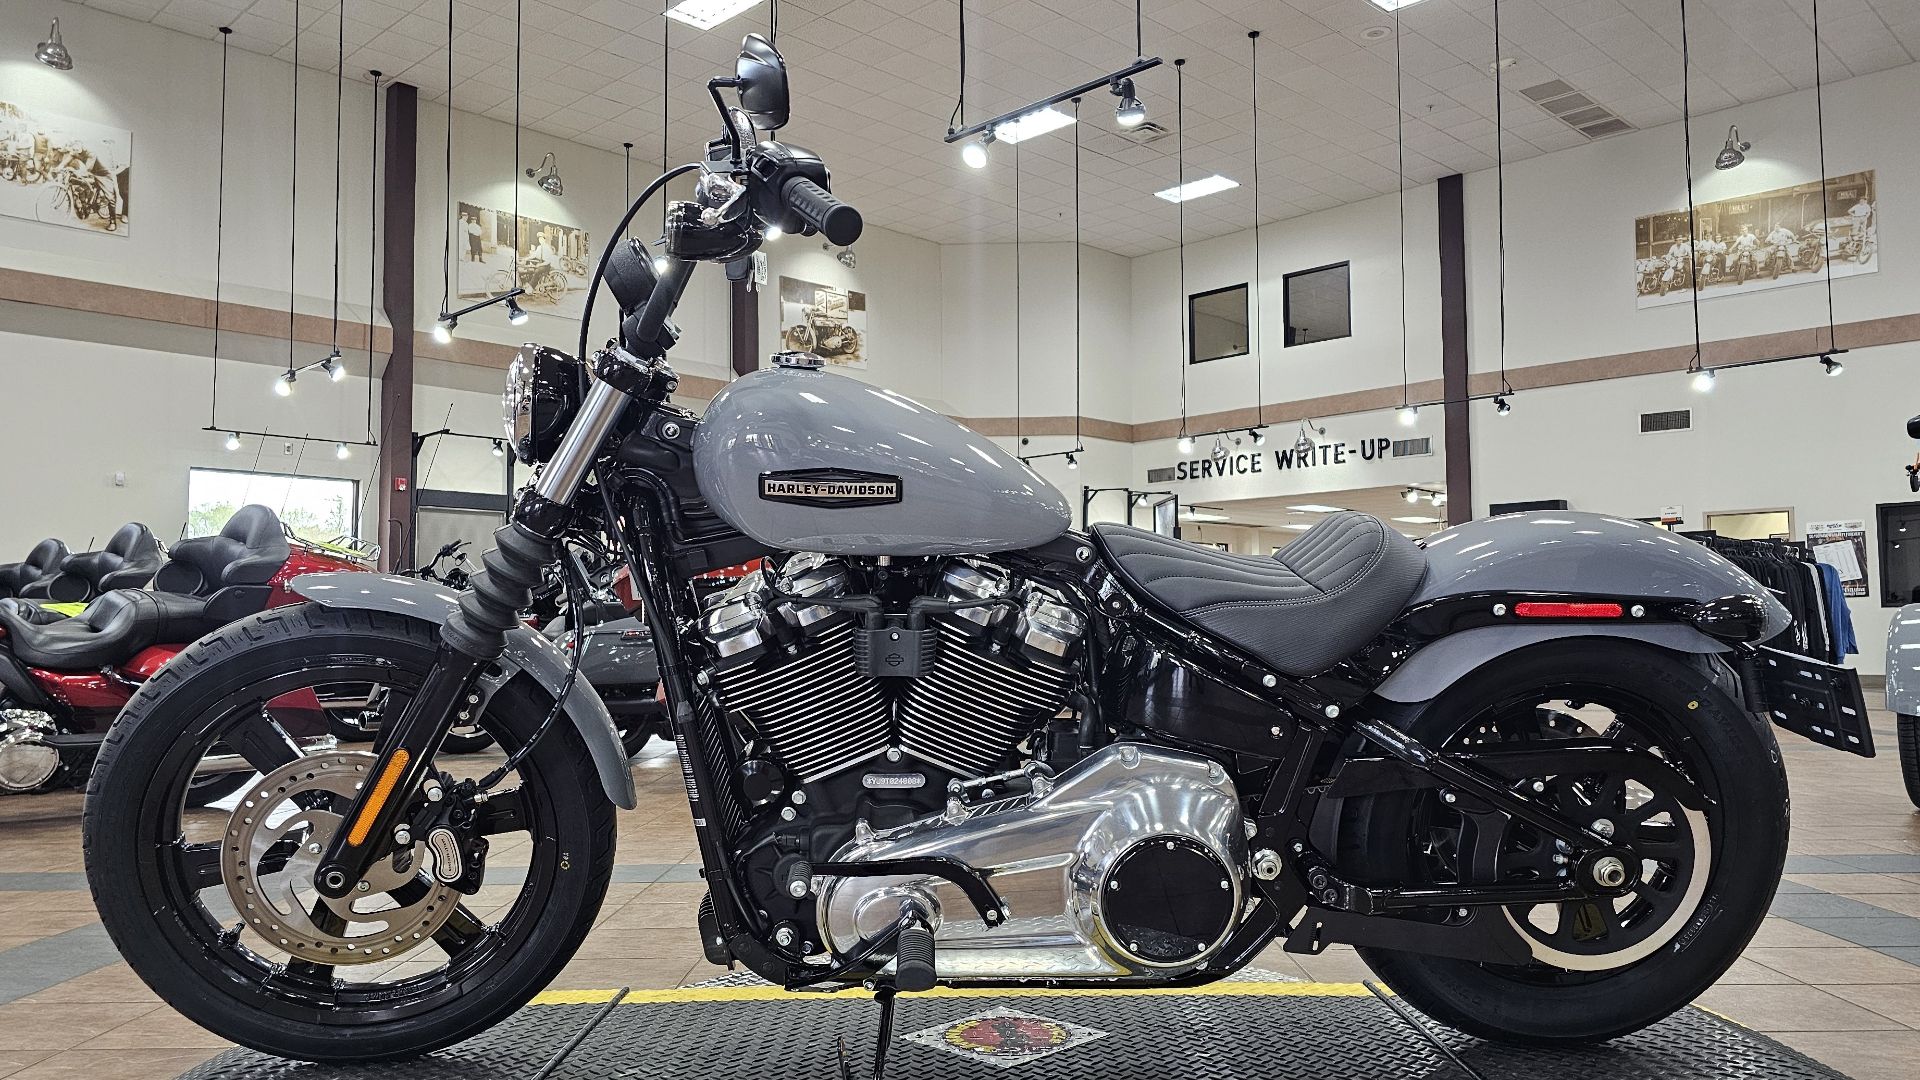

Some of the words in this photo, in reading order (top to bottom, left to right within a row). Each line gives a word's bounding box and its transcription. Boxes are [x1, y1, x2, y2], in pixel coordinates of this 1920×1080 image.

[1177, 453, 1262, 480] SERVICE
[1275, 438, 1391, 470] WRITE-UP
[767, 483, 894, 495] HARLEY-DAVIDSON
